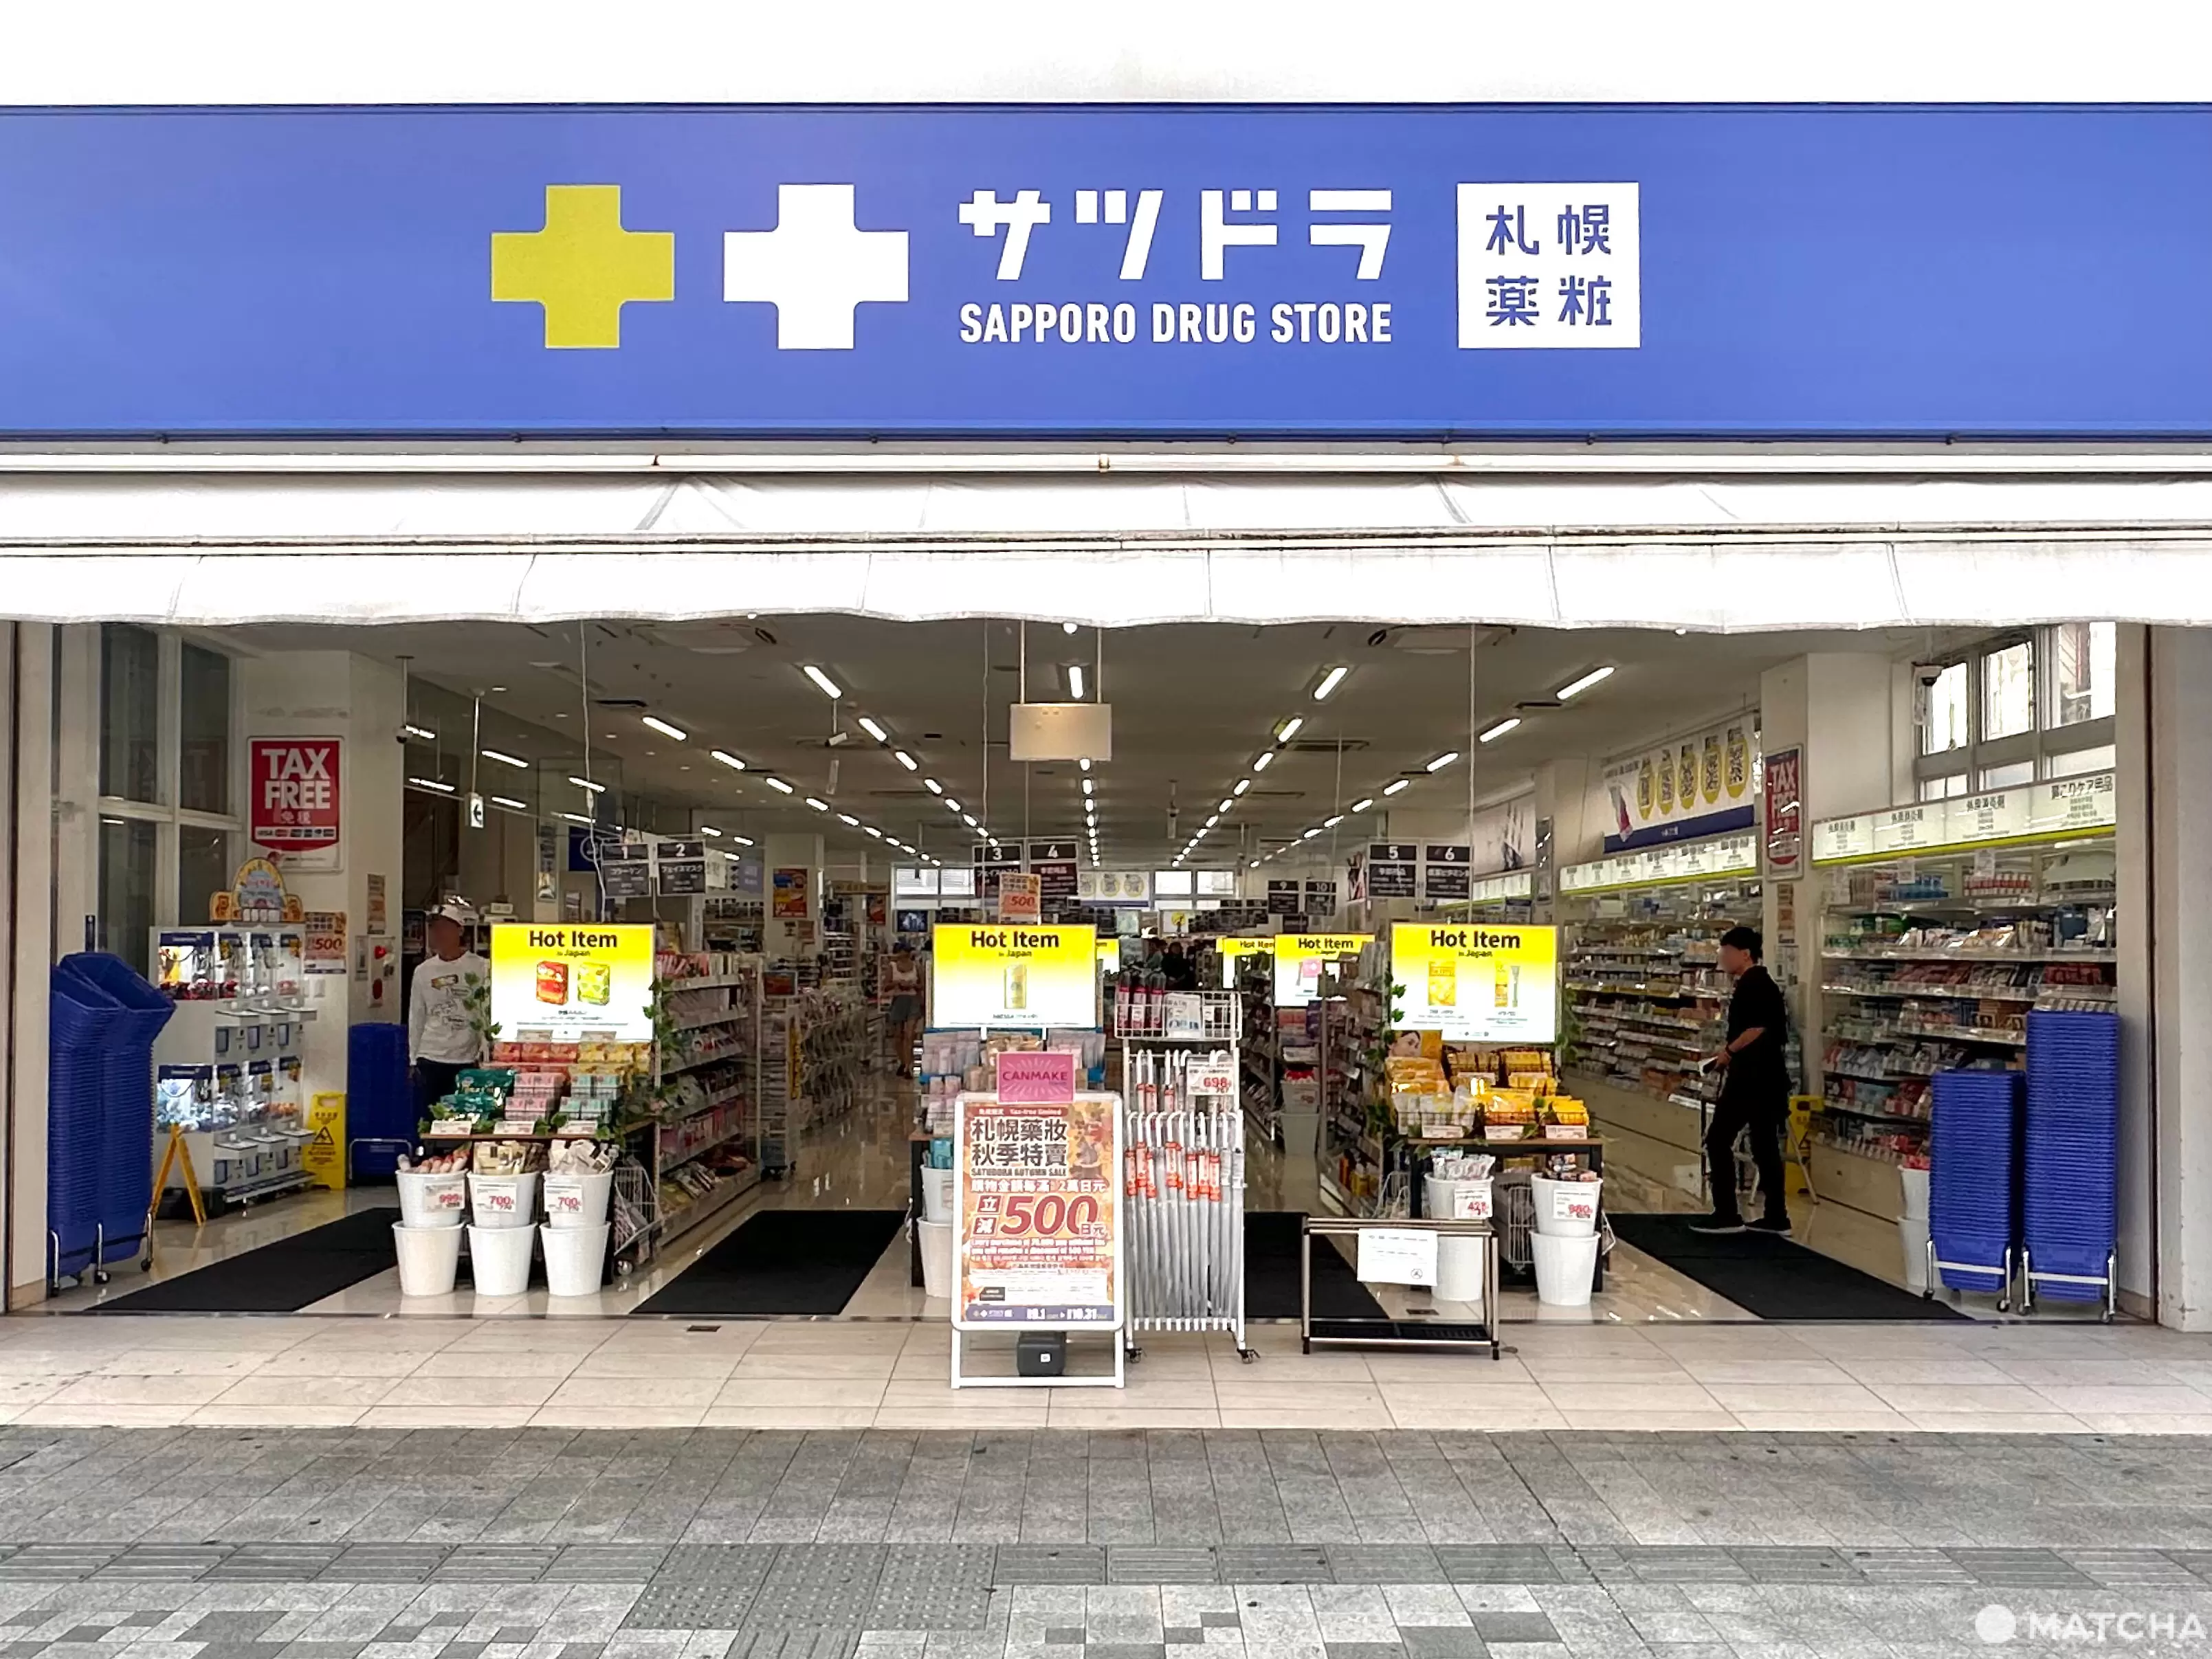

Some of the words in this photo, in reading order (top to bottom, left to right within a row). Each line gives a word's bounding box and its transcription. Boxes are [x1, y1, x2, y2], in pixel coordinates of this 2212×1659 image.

[958, 189, 1393, 281] サツドラ
[1485, 204, 1612, 256] 札幌
[1485, 275, 1612, 326] 薬粧
[960, 302, 1137, 344] SAPPORO
[1151, 302, 1257, 343] DRUG
[1270, 302, 1393, 343] STORE
[261, 748, 331, 779] TAX
[1769, 761, 1796, 792] TAX
[265, 780, 331, 810] FREE
[621, 845, 628, 859] 1
[676, 843, 685, 857] 2
[993, 847, 1003, 860] 3
[1047, 844, 1059, 858] 4
[1388, 846, 1399, 860] 5
[1445, 847, 1455, 860] 6
[1010, 896, 1036, 907] 500
[315, 937, 342, 950] 500
[529, 930, 565, 948] Hot
[571, 930, 617, 948] Item
[971, 931, 1007, 948] Hot
[1013, 931, 1060, 948] Item
[1298, 937, 1321, 948] Hot
[1324, 938, 1354, 949] Item
[1430, 929, 1468, 948] Hot
[1473, 930, 1521, 948] Item
[1006, 949, 1033, 959] Japan
[1002, 1071, 1068, 1082] CANMAKE
[971, 1142, 1068, 1167] 秋季特賣
[489, 1195, 511, 1205] 700
[557, 1196, 578, 1206] 700
[1000, 1194, 1099, 1236] 500
[1080, 1223, 1106, 1235] 日元
